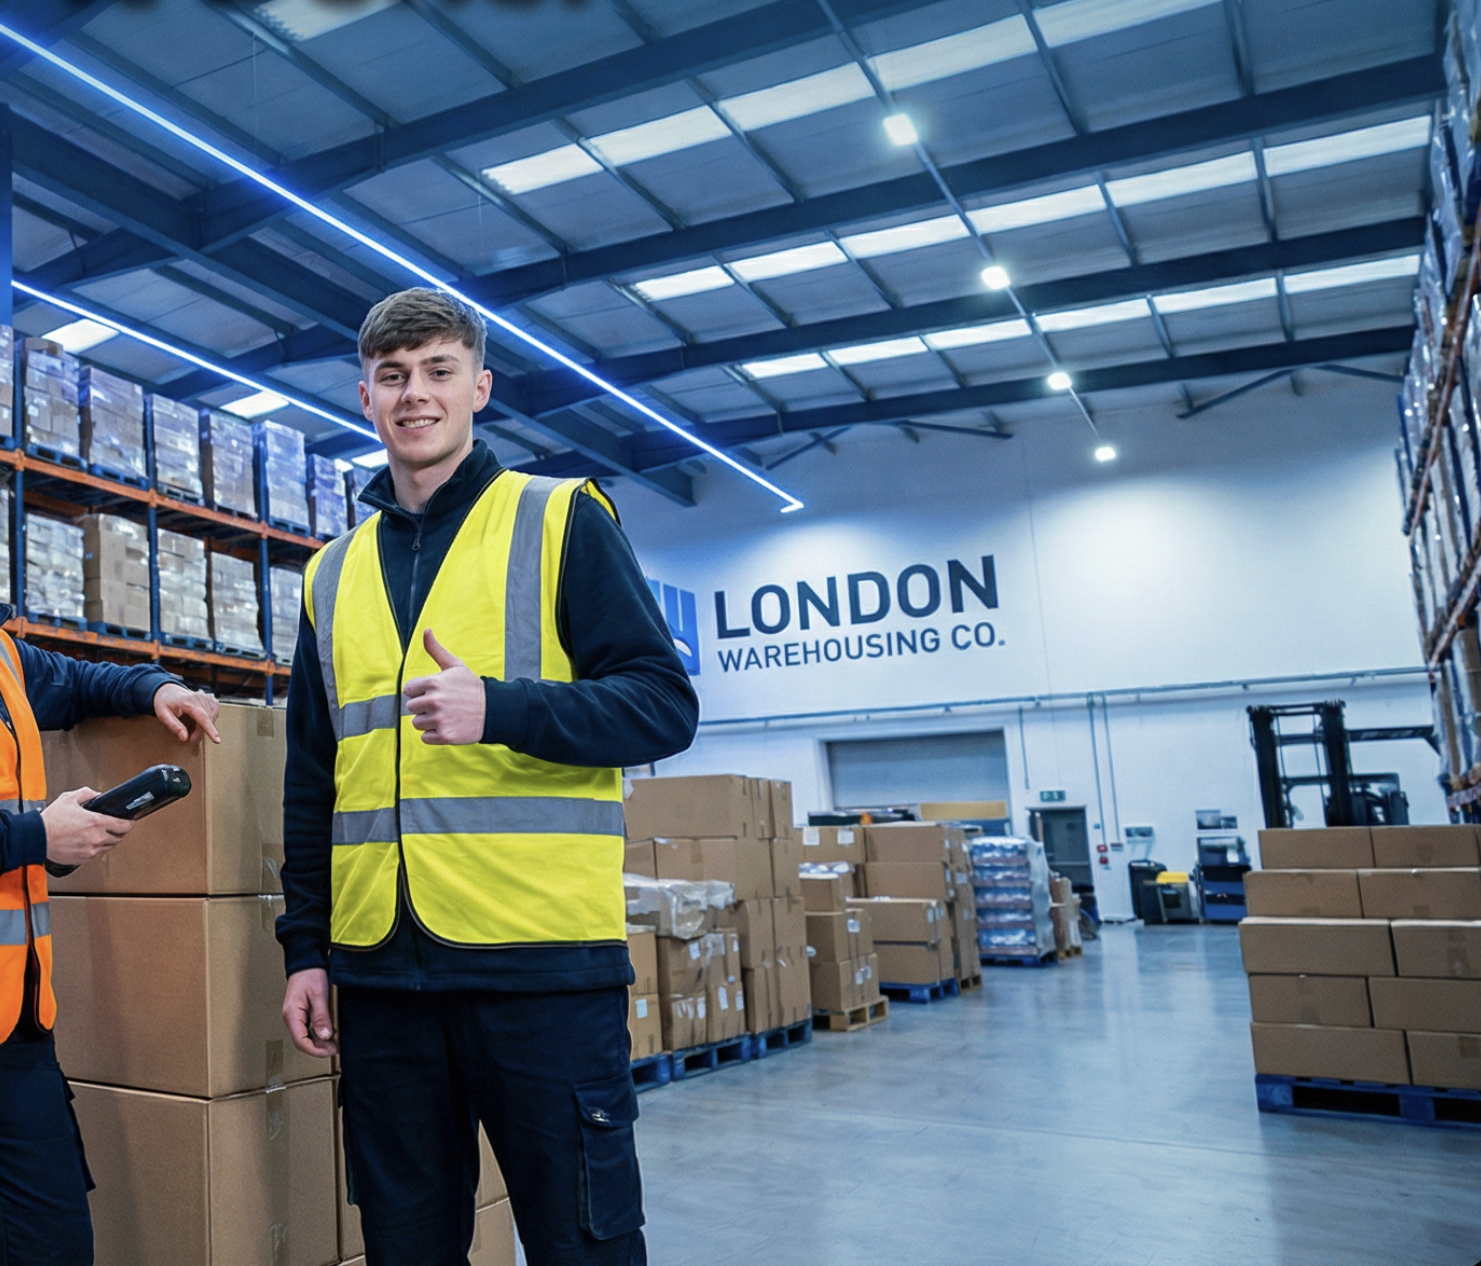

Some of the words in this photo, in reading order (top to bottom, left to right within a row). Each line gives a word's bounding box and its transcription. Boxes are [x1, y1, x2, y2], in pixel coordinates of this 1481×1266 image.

[714, 554, 999, 639] LONDON
[718, 627, 941, 672] WAREHOUSING
[951, 621, 1006, 651] CO.
